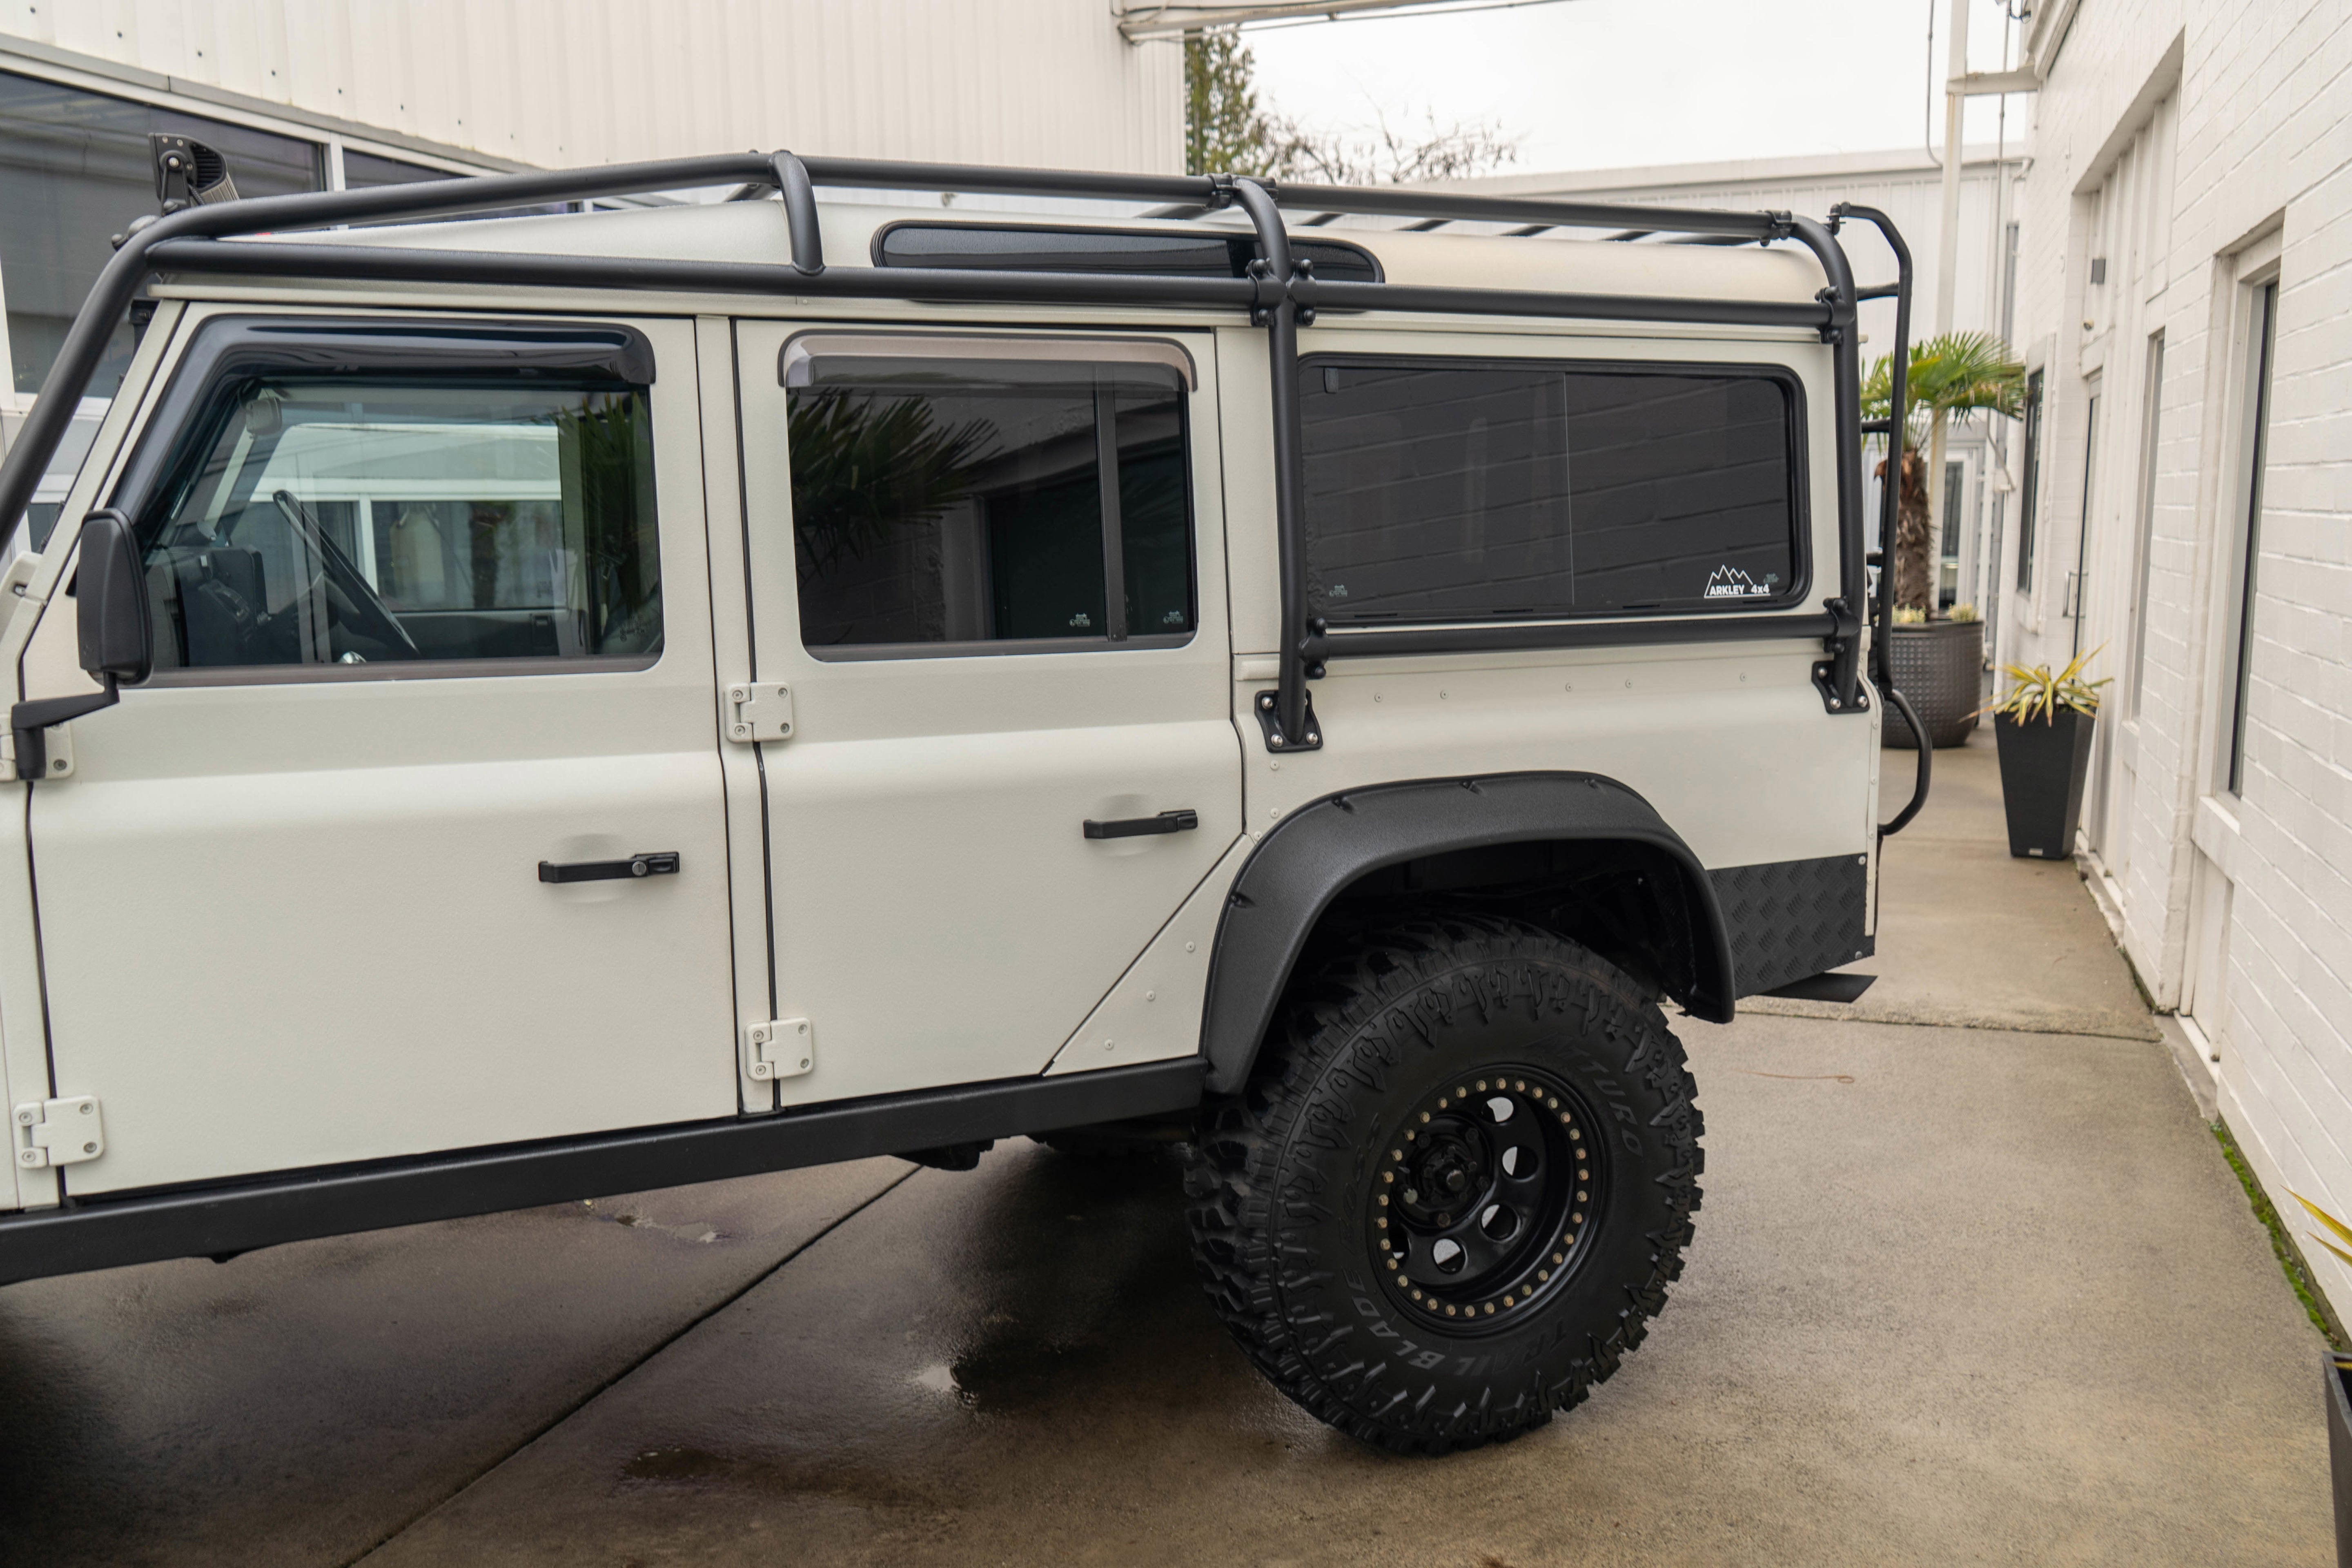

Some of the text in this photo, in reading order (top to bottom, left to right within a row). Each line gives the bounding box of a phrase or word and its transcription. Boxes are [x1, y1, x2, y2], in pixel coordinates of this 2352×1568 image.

[1709, 584, 1770, 595] ARKLEY 4x4
[1521, 1032, 1644, 1157] ATTURO
[1340, 1264, 1446, 1370] BLADE
